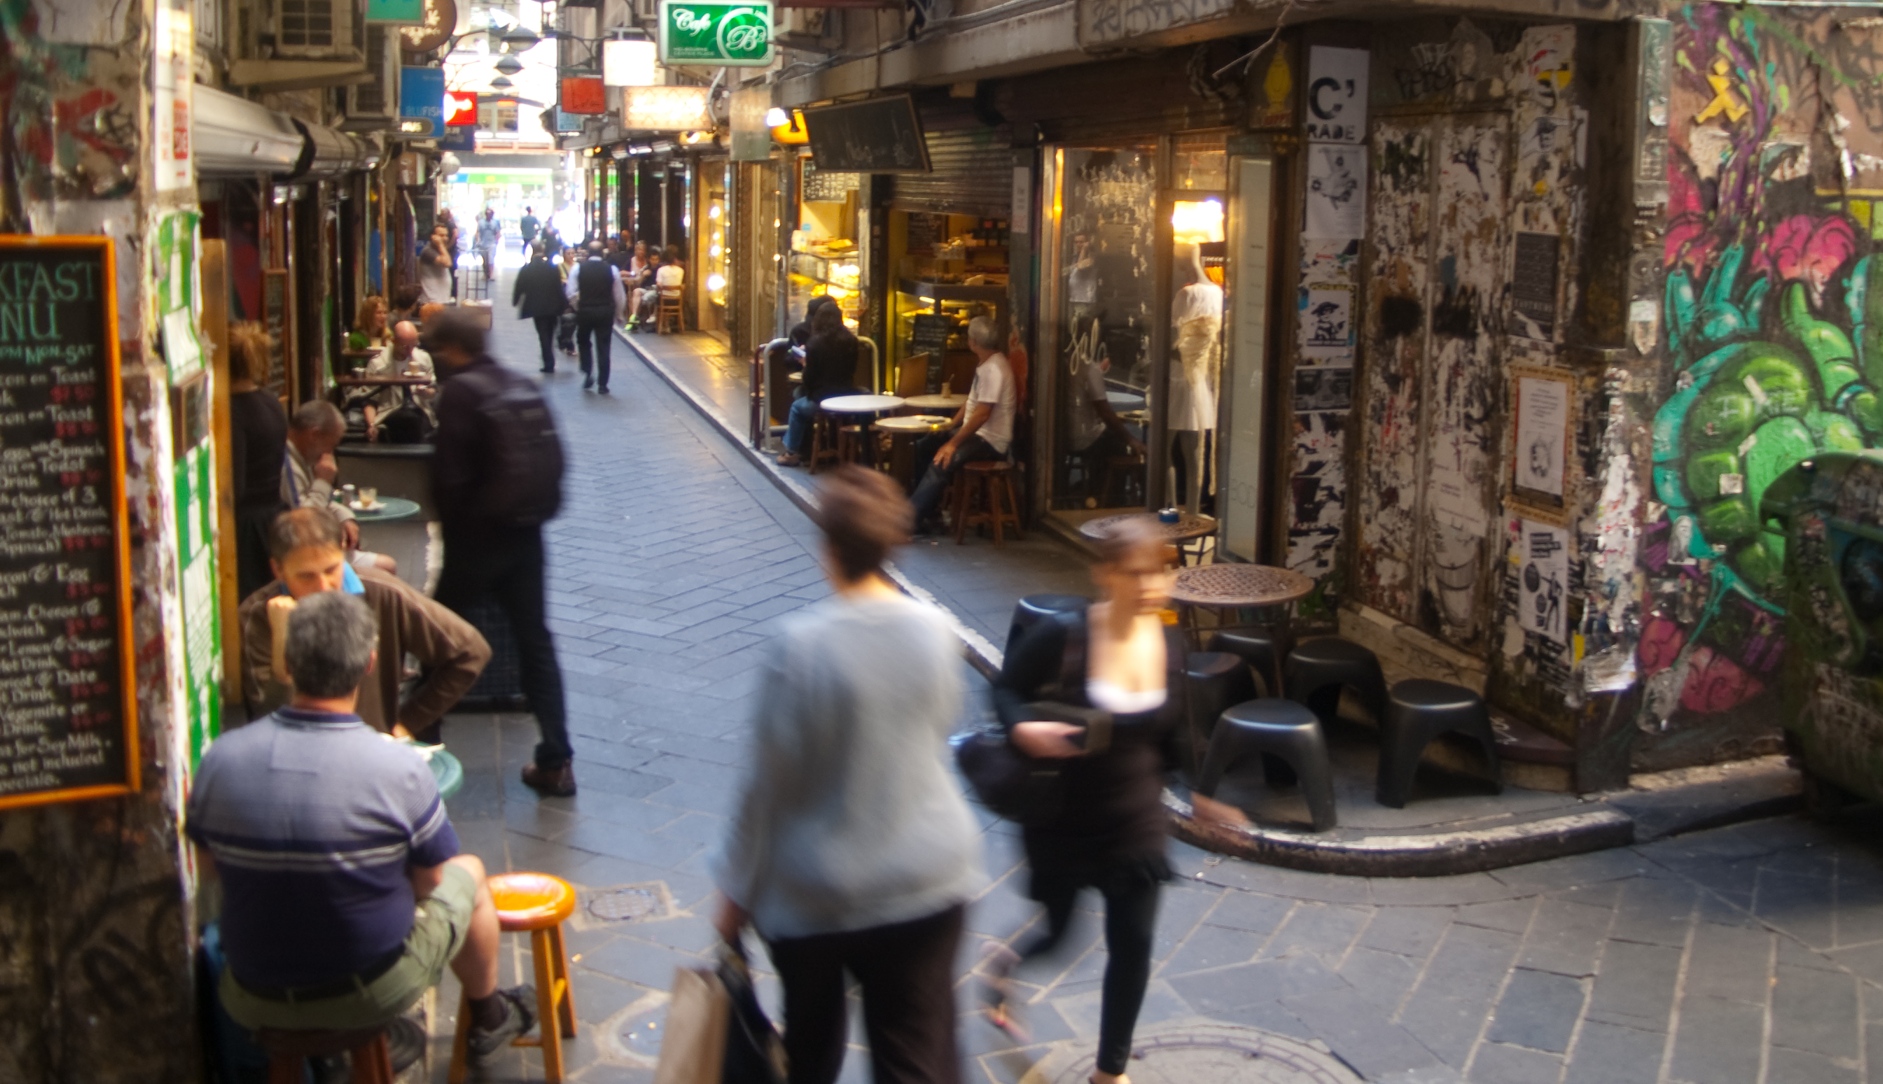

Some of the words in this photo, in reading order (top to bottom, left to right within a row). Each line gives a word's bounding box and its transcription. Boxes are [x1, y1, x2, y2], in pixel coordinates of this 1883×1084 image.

[50, 365, 96, 385] Toast
[45, 403, 95, 423] Toast
[38, 455, 87, 475] Toast
[82, 484, 98, 505] 3
[28, 602, 79, 620] Cheese
[56, 668, 97, 687] Date
[42, 749, 106, 770] included
